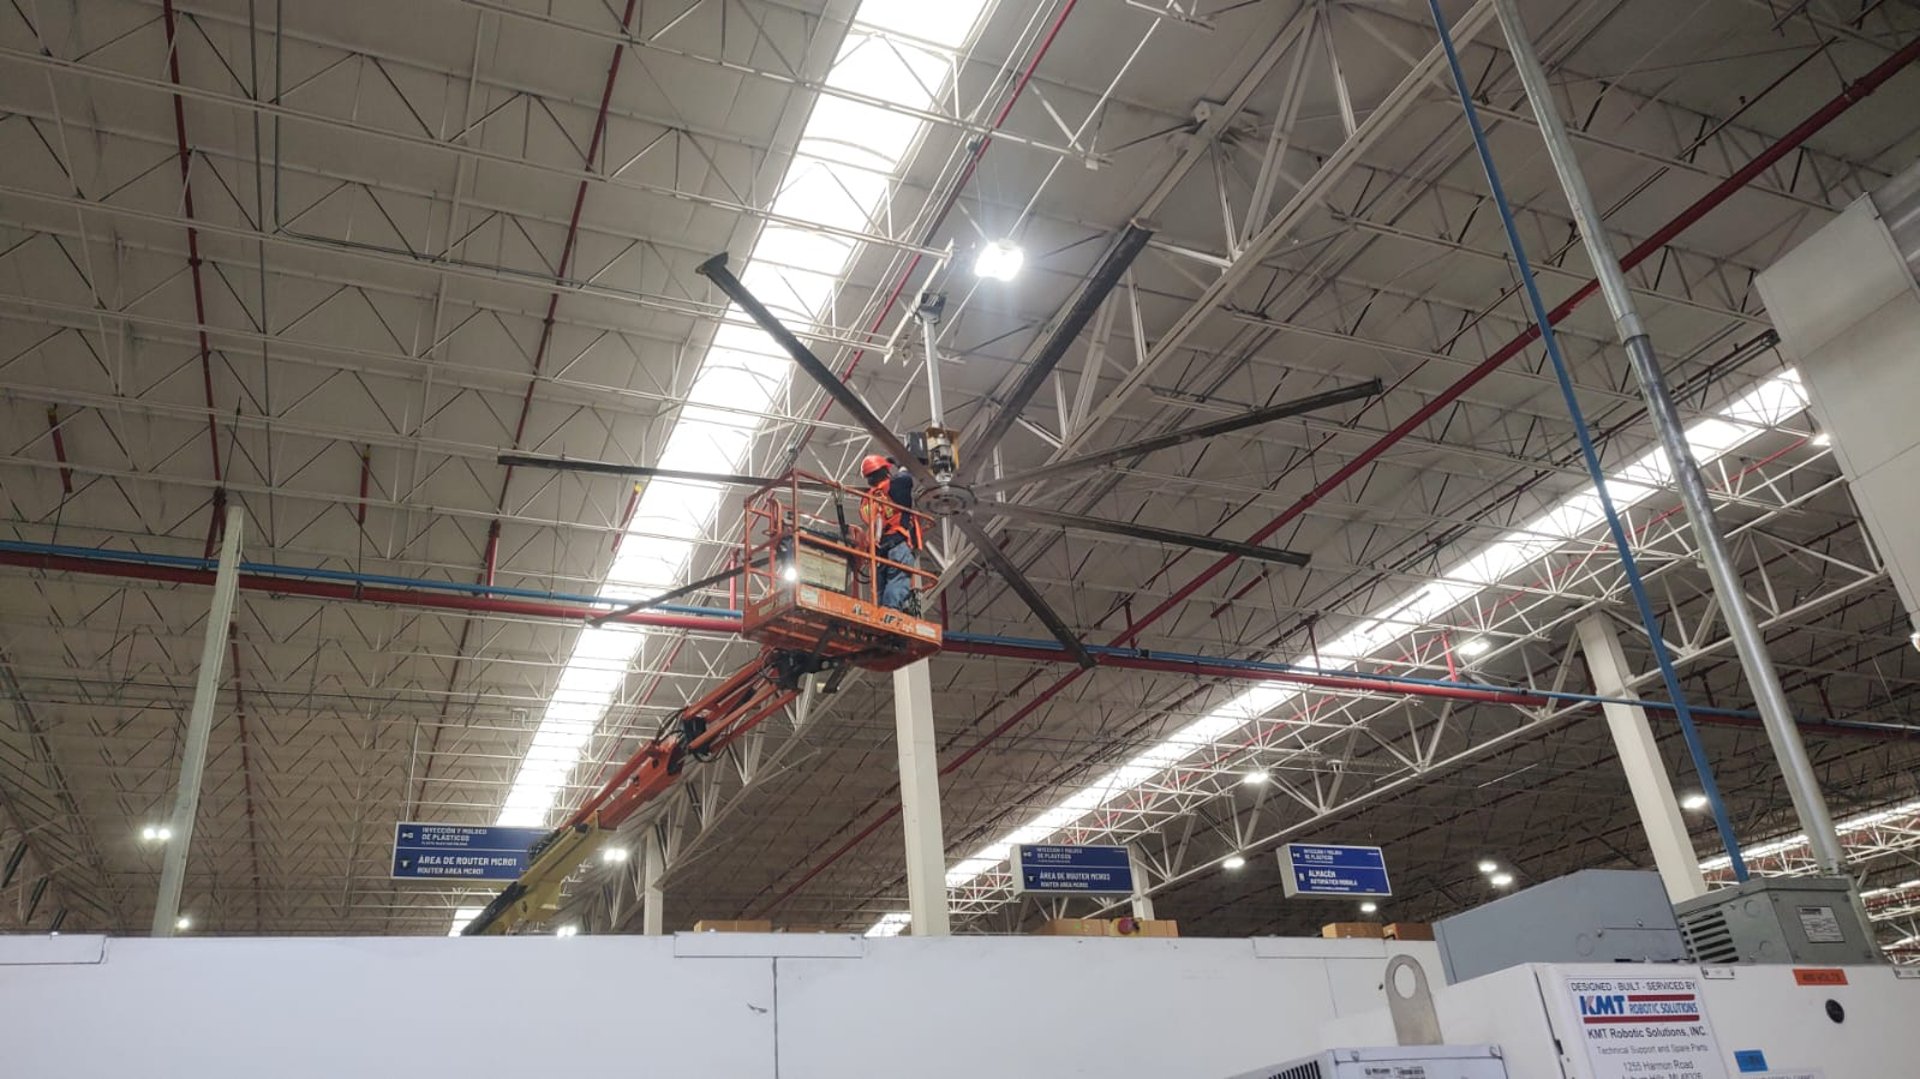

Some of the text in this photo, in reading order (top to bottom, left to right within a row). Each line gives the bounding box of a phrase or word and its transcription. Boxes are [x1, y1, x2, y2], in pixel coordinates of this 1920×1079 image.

[418, 854, 441, 864] ÁREA
[443, 856, 455, 864] DE
[456, 857, 489, 866] ROUTER
[1040, 870, 1056, 880] ÁREA
[1057, 872, 1065, 880] DE
[1308, 868, 1336, 878] ALMACÉN
[1571, 981, 1696, 992] DESIGNED BUILT SERVICED BY
[1579, 995, 1626, 1015] KMT
[1628, 1002, 1698, 1014] ROBOTIC SOLUTIONS
[1587, 1028, 1608, 1039] KMT
[1610, 1028, 1644, 1038] Robotic
[1597, 1044, 1708, 1056] Technical Support and Spare Parts
[1644, 1061, 1672, 1071] Harmon
[1674, 1060, 1694, 1069] Road
